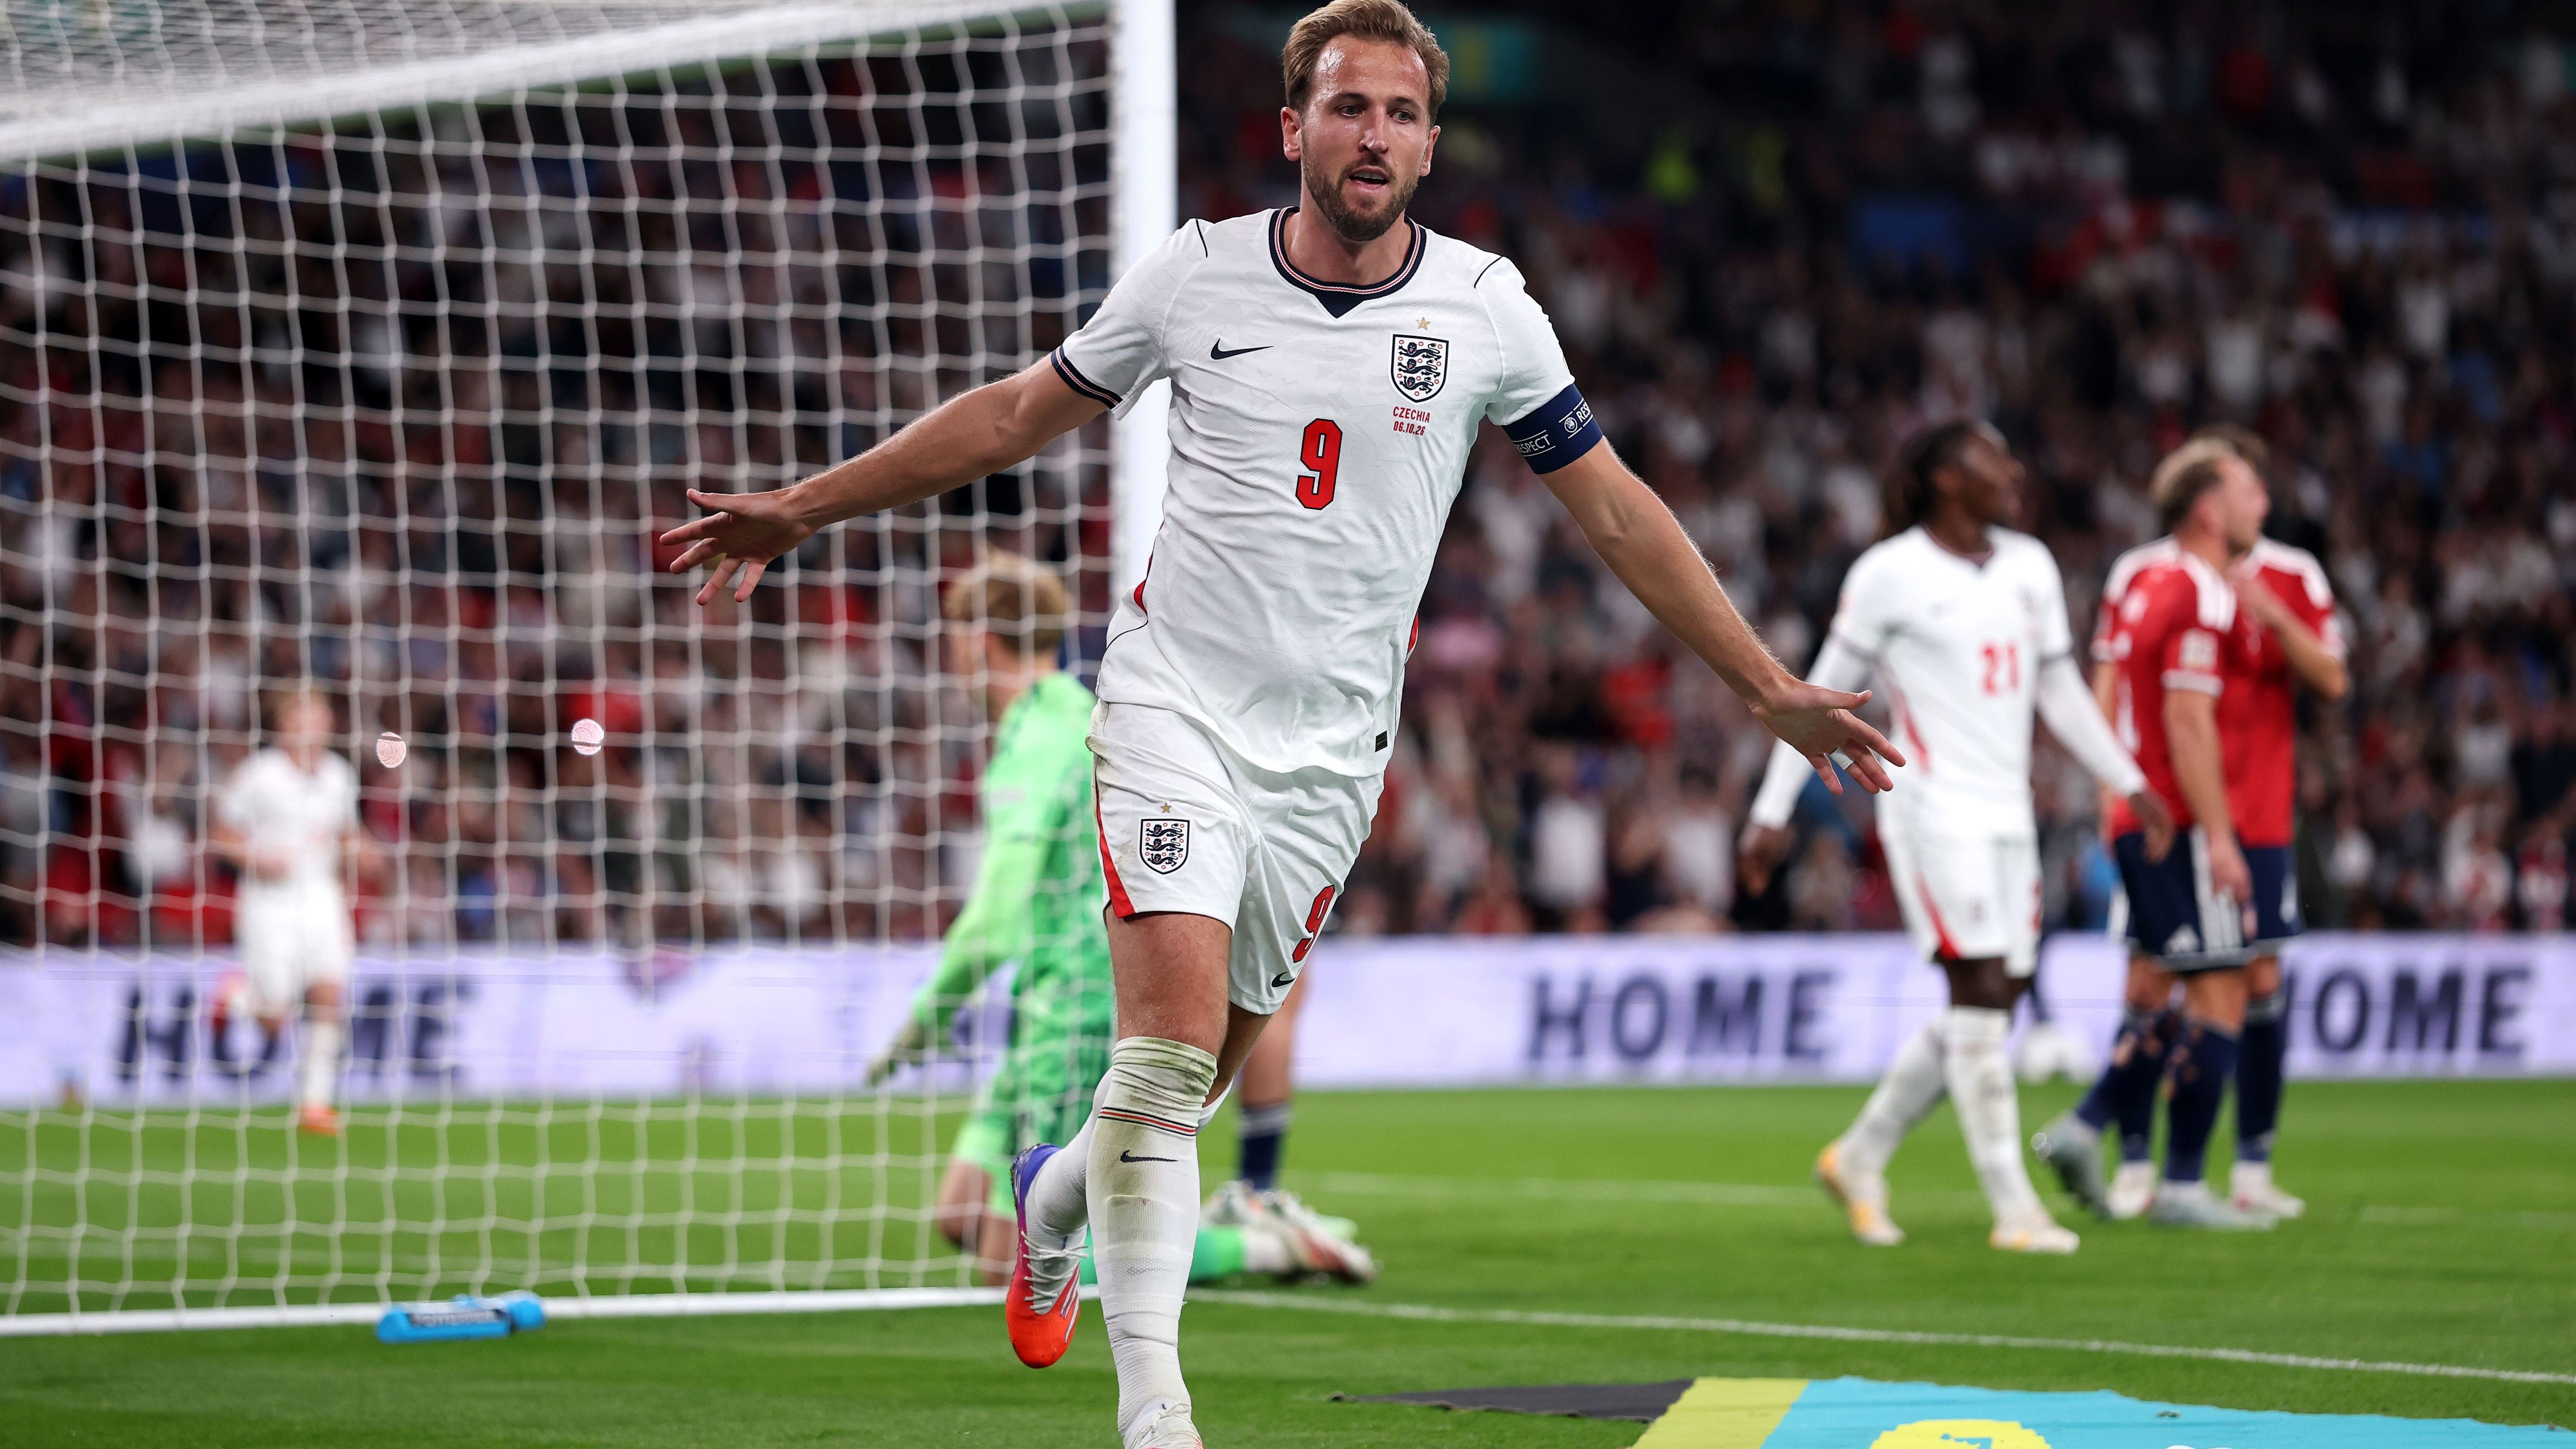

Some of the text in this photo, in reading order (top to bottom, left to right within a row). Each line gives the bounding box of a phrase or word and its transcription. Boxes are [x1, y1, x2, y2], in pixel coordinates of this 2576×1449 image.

[1393, 406, 1430, 423] CZECHIA
[1393, 421, 1425, 436] 06.10.26
[1515, 434, 1550, 453] ESPECT
[1295, 418, 1343, 510] 9
[1980, 642, 2020, 697] 21
[1292, 884, 1336, 964] 9
[1528, 968, 1835, 1061] HOME
[2279, 967, 2530, 1054] OME
